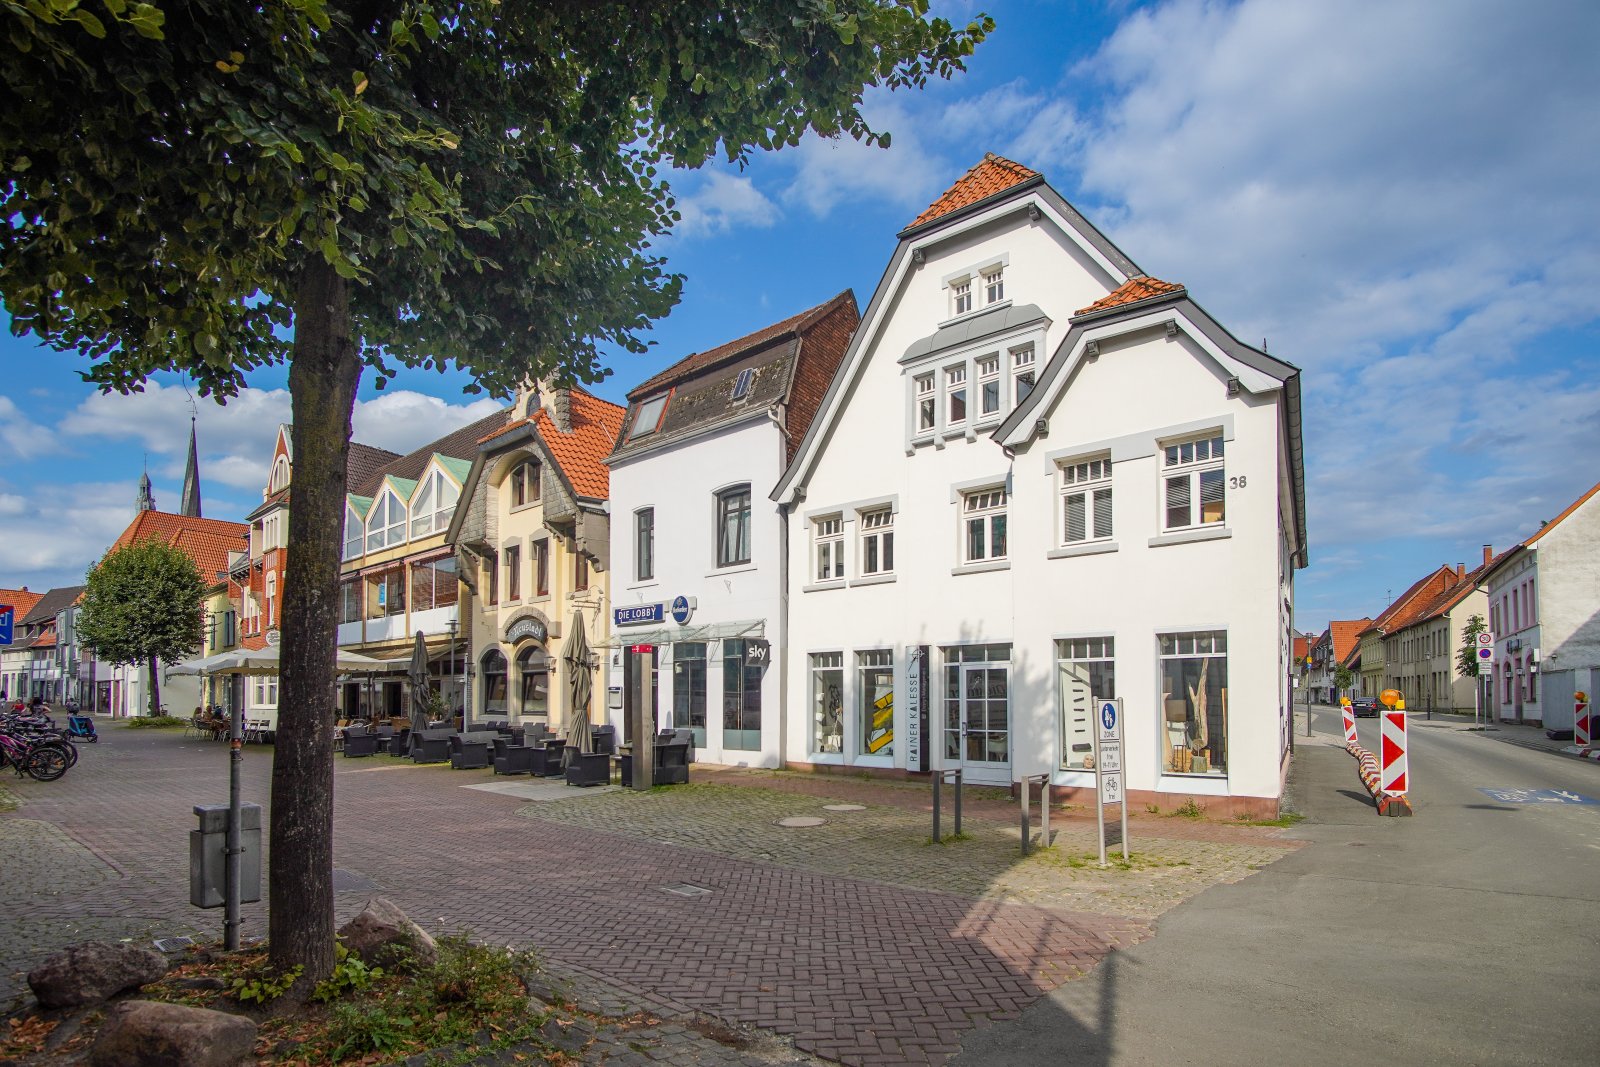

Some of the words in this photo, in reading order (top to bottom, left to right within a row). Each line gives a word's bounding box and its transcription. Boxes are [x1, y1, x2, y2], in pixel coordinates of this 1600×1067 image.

[1230, 475, 1247, 489] 38
[618, 610, 630, 620] DIE
[632, 607, 656, 618] LOBBY
[748, 645, 767, 660] sky
[909, 673, 918, 719] KALESSE
[909, 723, 918, 762] RAINER
